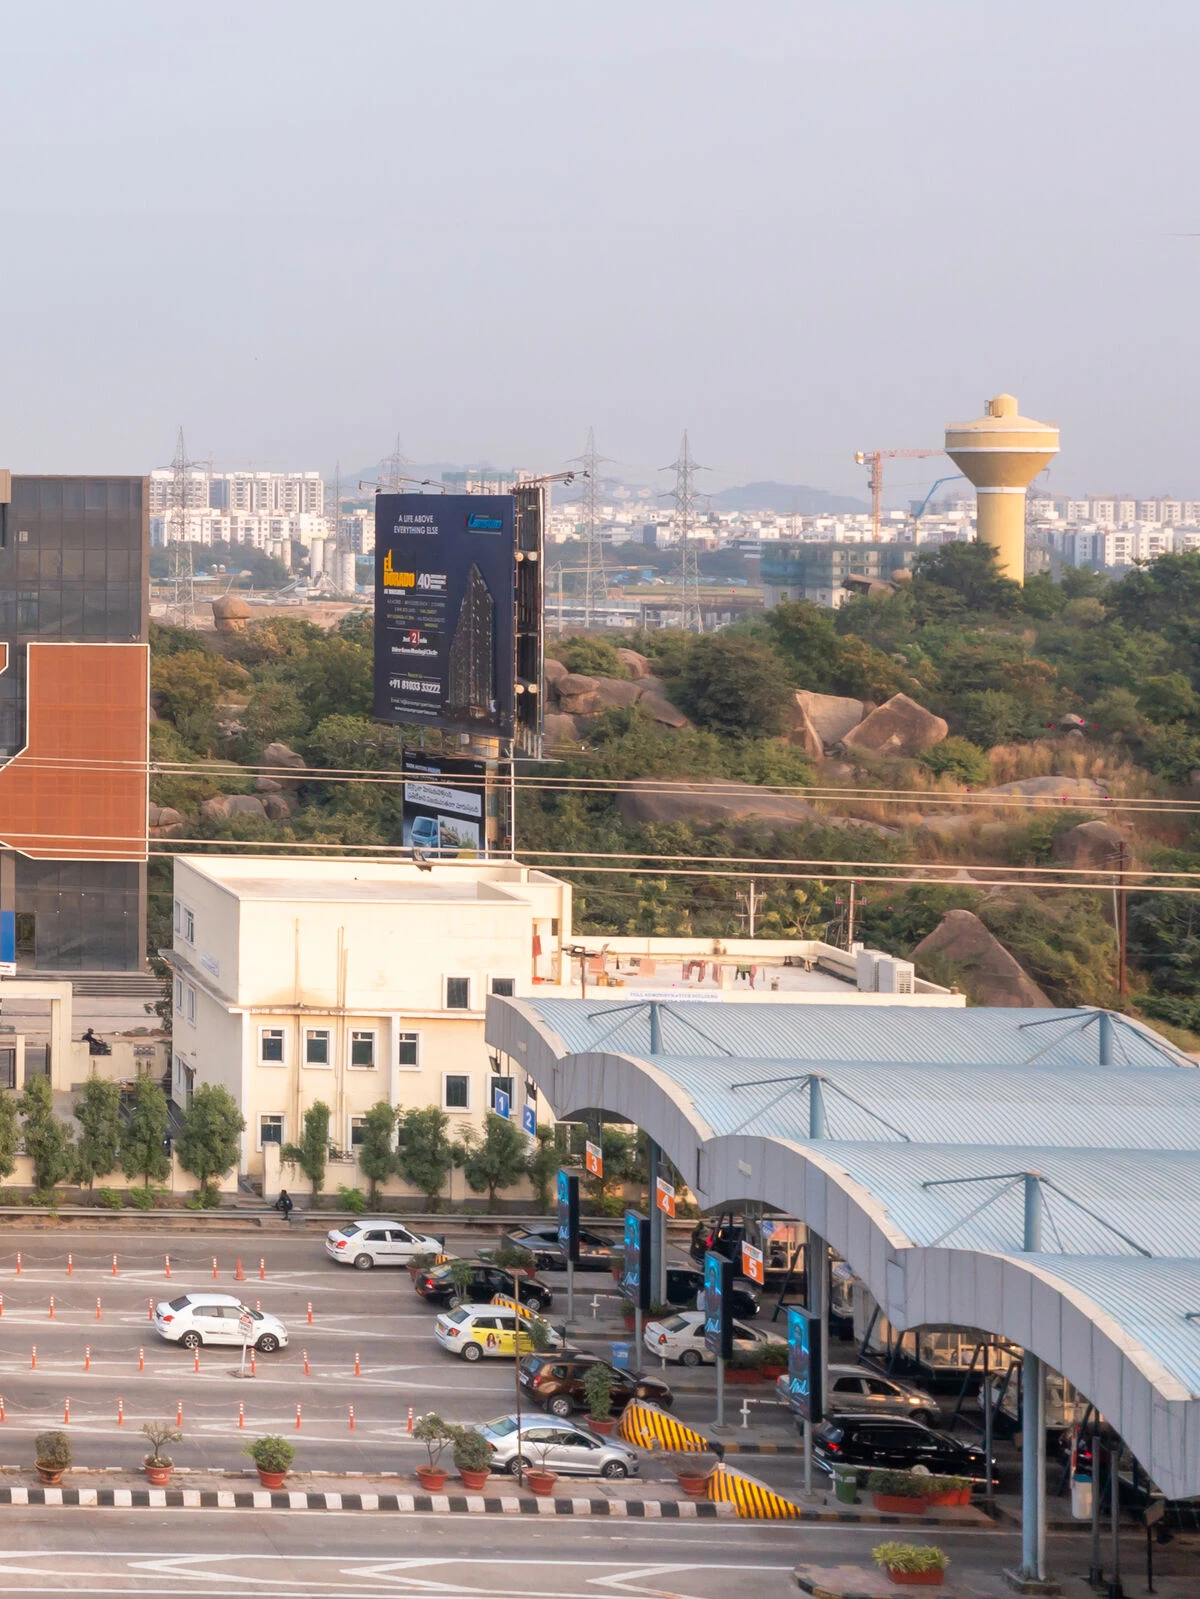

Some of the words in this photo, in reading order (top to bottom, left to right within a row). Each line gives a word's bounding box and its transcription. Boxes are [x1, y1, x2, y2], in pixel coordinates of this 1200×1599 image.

[403, 515, 413, 523] LIFE
[414, 515, 434, 523] ABOVE
[393, 526, 425, 535] EVERYTHING
[426, 526, 439, 535] ELSE
[417, 573, 430, 589] 40
[389, 679, 401, 689] +91
[498, 1096, 504, 1111] 1
[525, 1111, 532, 1128] 2
[591, 1155, 598, 1172] 3
[662, 1194, 670, 1212] 4
[749, 1257, 757, 1278] 5
